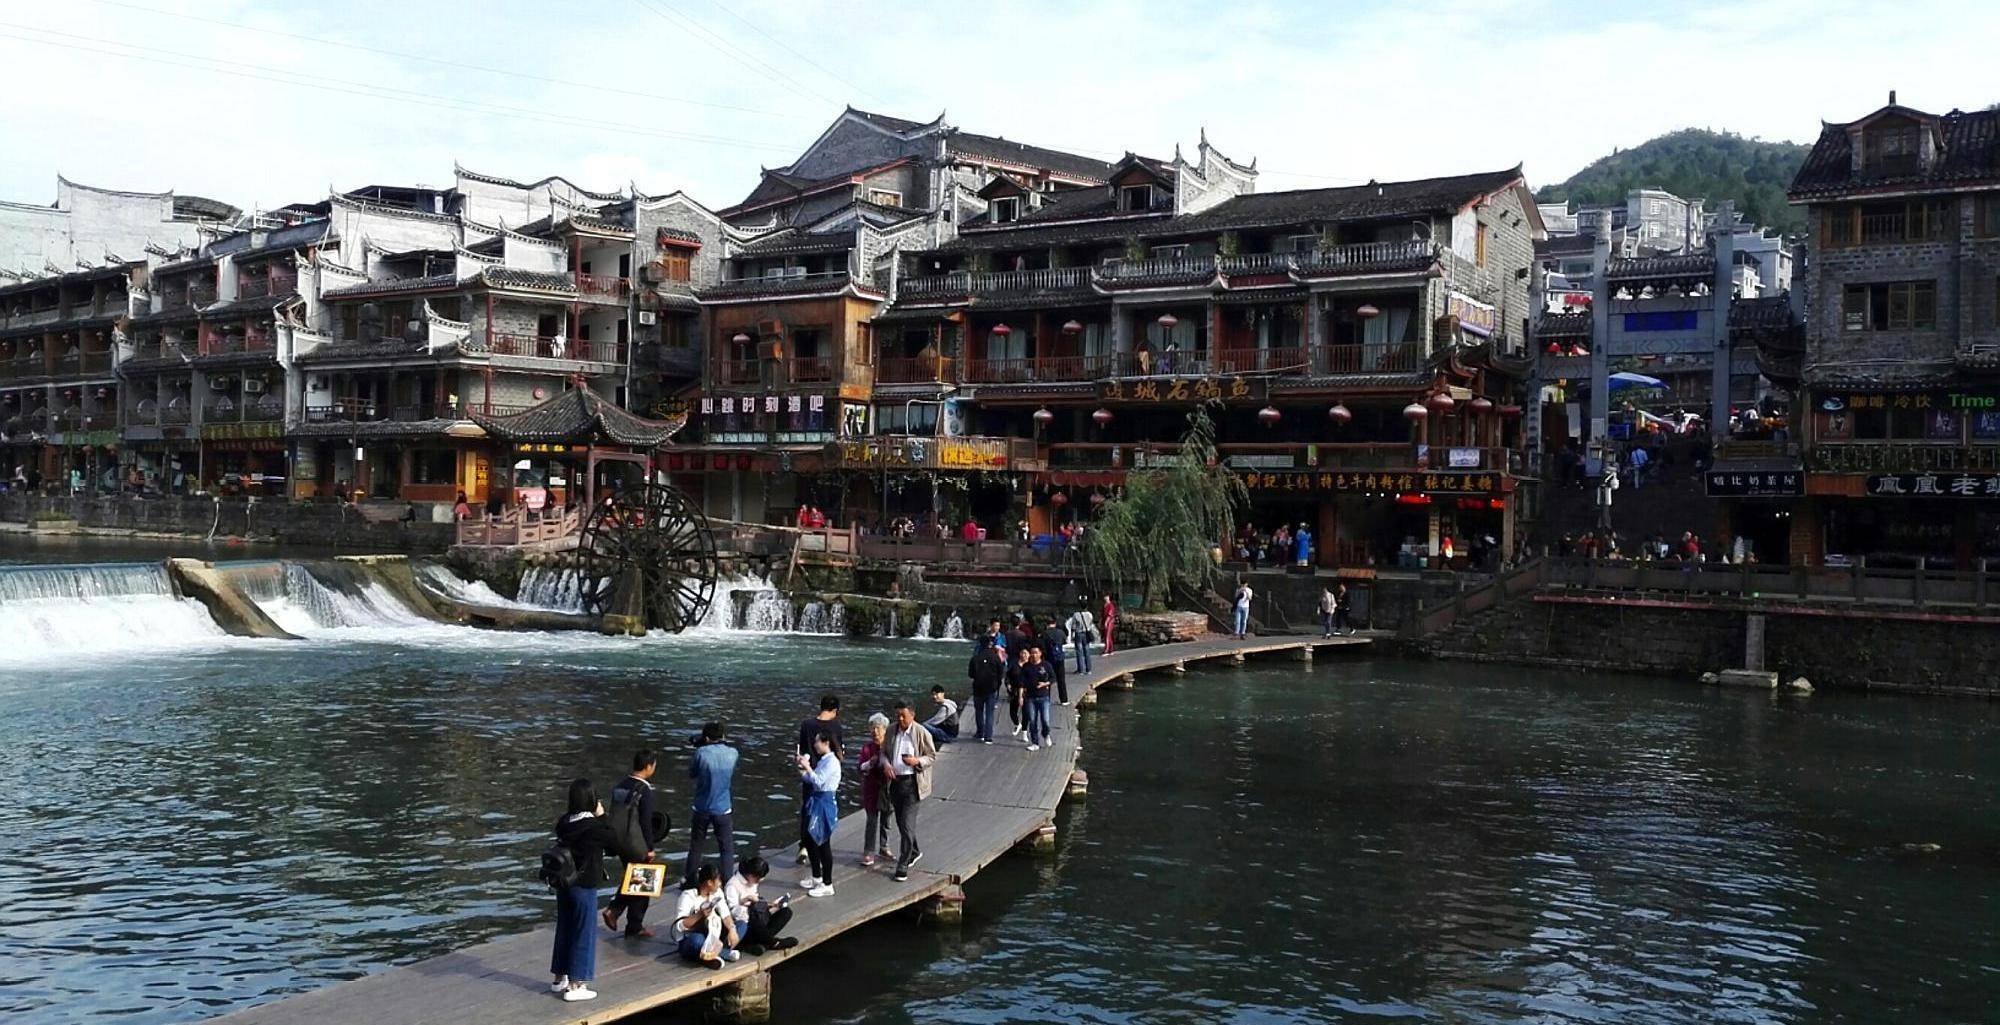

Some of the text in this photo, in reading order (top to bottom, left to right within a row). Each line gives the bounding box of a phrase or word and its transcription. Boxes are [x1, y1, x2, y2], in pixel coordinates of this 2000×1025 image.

[701, 395, 824, 414] 心跳时刻酒吧
[1849, 394, 1884, 408] 咖啡
[1948, 393, 1996, 408] Time
